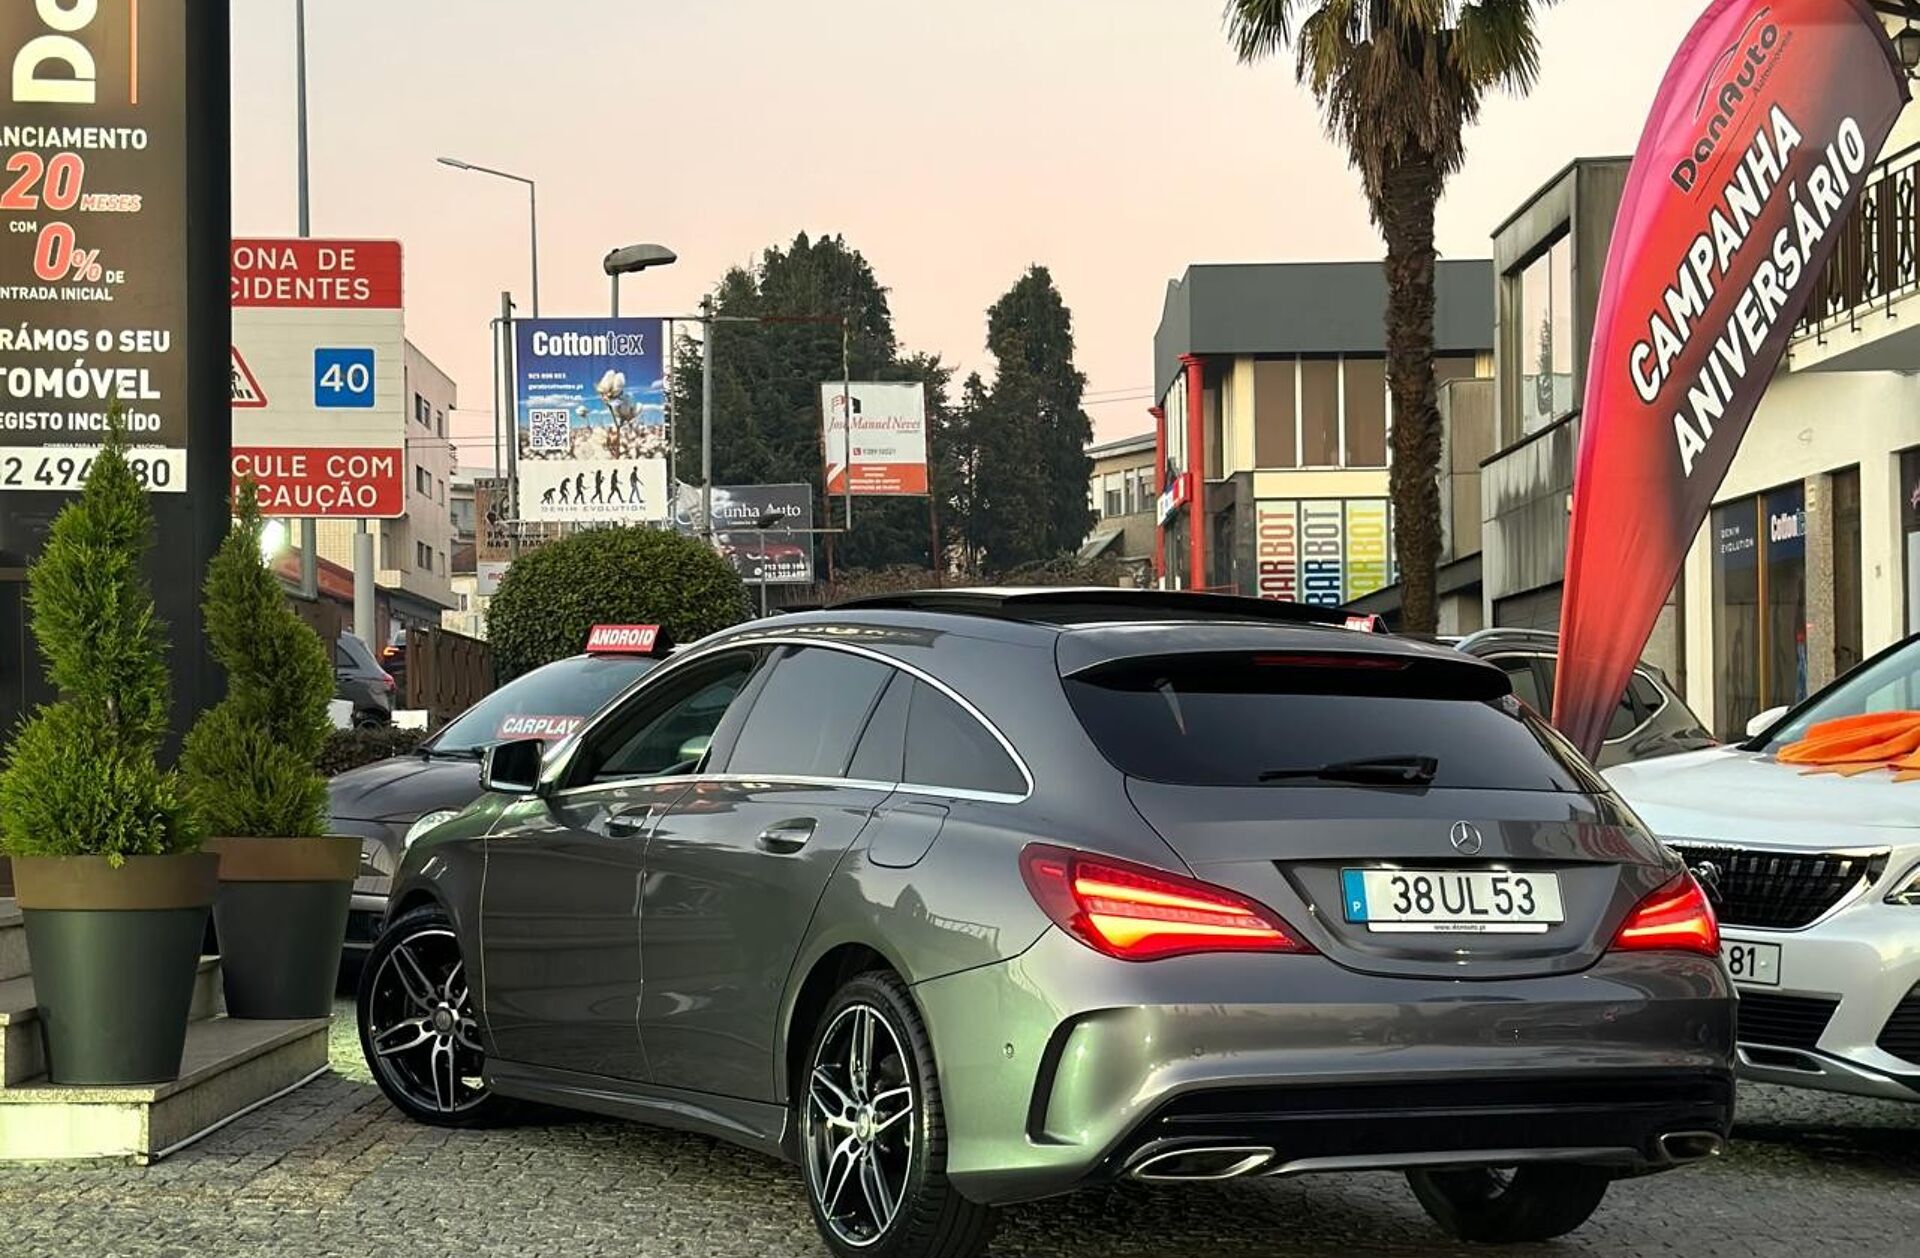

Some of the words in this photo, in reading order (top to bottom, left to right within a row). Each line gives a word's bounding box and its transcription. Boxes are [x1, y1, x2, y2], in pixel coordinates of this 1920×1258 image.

[1671, 23, 1778, 193] DanAuto
[0, 126, 147, 150] NCIAMENTO
[80, 193, 142, 212] MESES
[9, 221, 37, 233] COM
[34, 221, 102, 281] 0%
[106, 270, 124, 283] DE
[318, 249, 356, 271] DE
[1630, 104, 1801, 403] CAMPANHA
[61, 287, 113, 301] INICIAL
[1672, 116, 1866, 478] ANIVERSÁRIO
[96, 329, 113, 352] O
[119, 329, 170, 353] SEU
[532, 330, 645, 356] Cottontex
[320, 363, 369, 393] 40
[68, 408, 161, 431] INCLÍDO
[327, 455, 393, 478] COM
[583, 504, 646, 512] EVOLUTION
[1349, 510, 1385, 601] ARBOT
[588, 628, 656, 646] ANDROID
[502, 718, 580, 735] CARPLAY
[1353, 902, 1361, 912] P
[1729, 945, 1756, 977] 81
